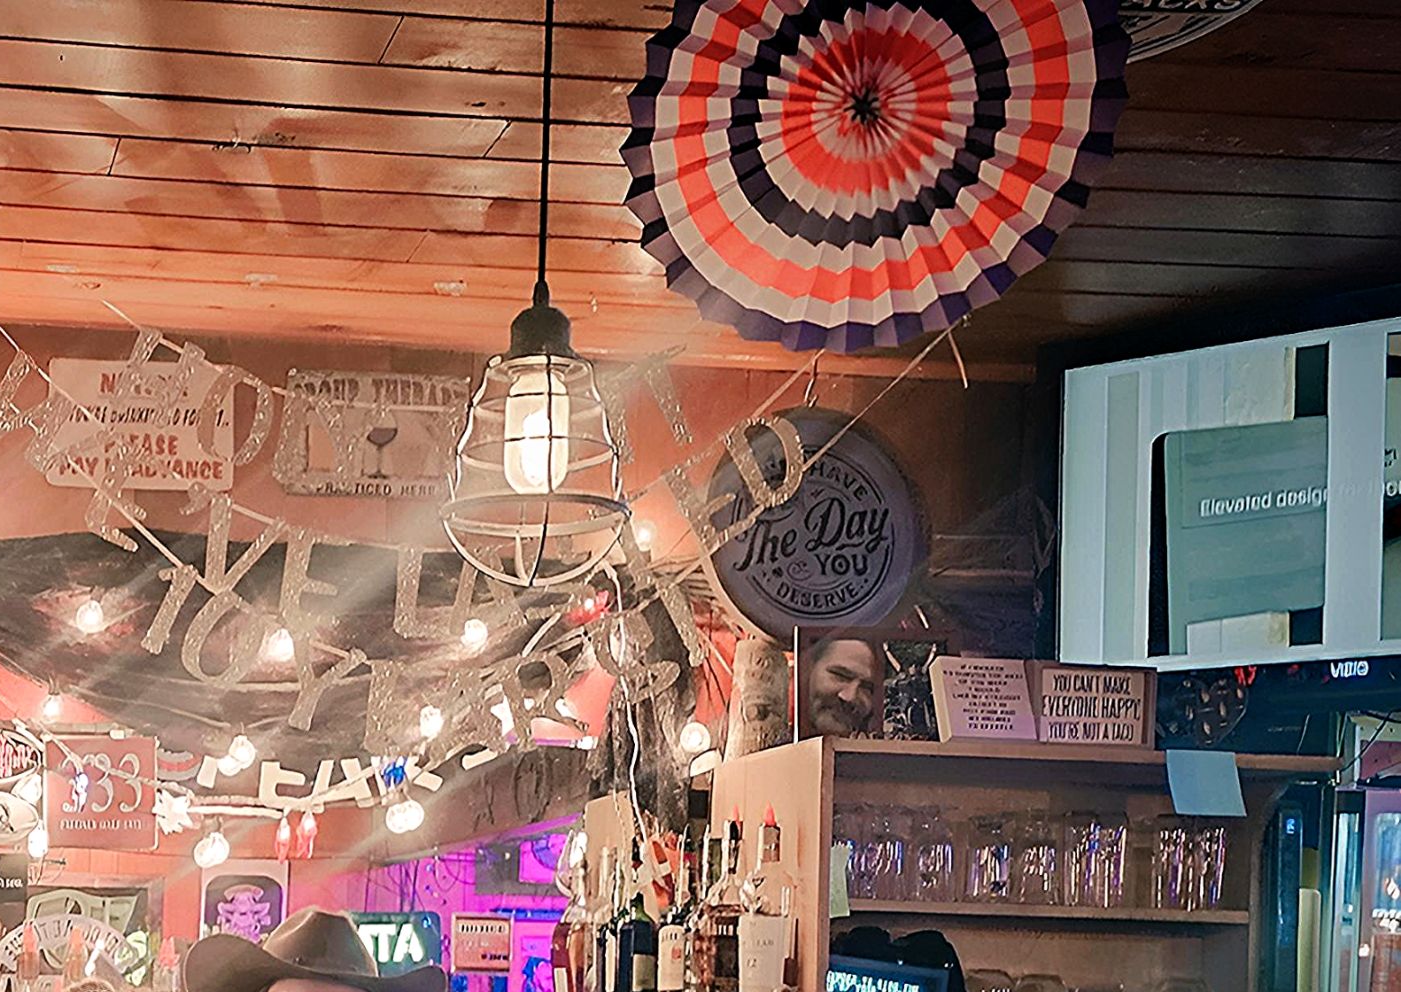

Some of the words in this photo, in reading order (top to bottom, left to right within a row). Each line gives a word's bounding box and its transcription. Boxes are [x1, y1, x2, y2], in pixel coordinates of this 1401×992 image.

[104, 433, 179, 456] EASE
[809, 460, 868, 502] HAVE
[1199, 491, 1272, 517] Elevated
[733, 520, 797, 571] The
[804, 498, 890, 554] Day
[814, 553, 868, 577] YOU
[776, 581, 859, 609] DESERVE
[1053, 674, 1073, 693] YOU
[1074, 675, 1100, 695] CAN'T
[1103, 676, 1131, 695] MAKE
[1042, 695, 1098, 718] EVERYONE
[1102, 697, 1141, 721] HAPPY
[1082, 723, 1100, 741] NOT
[1102, 723, 1110, 741] A
